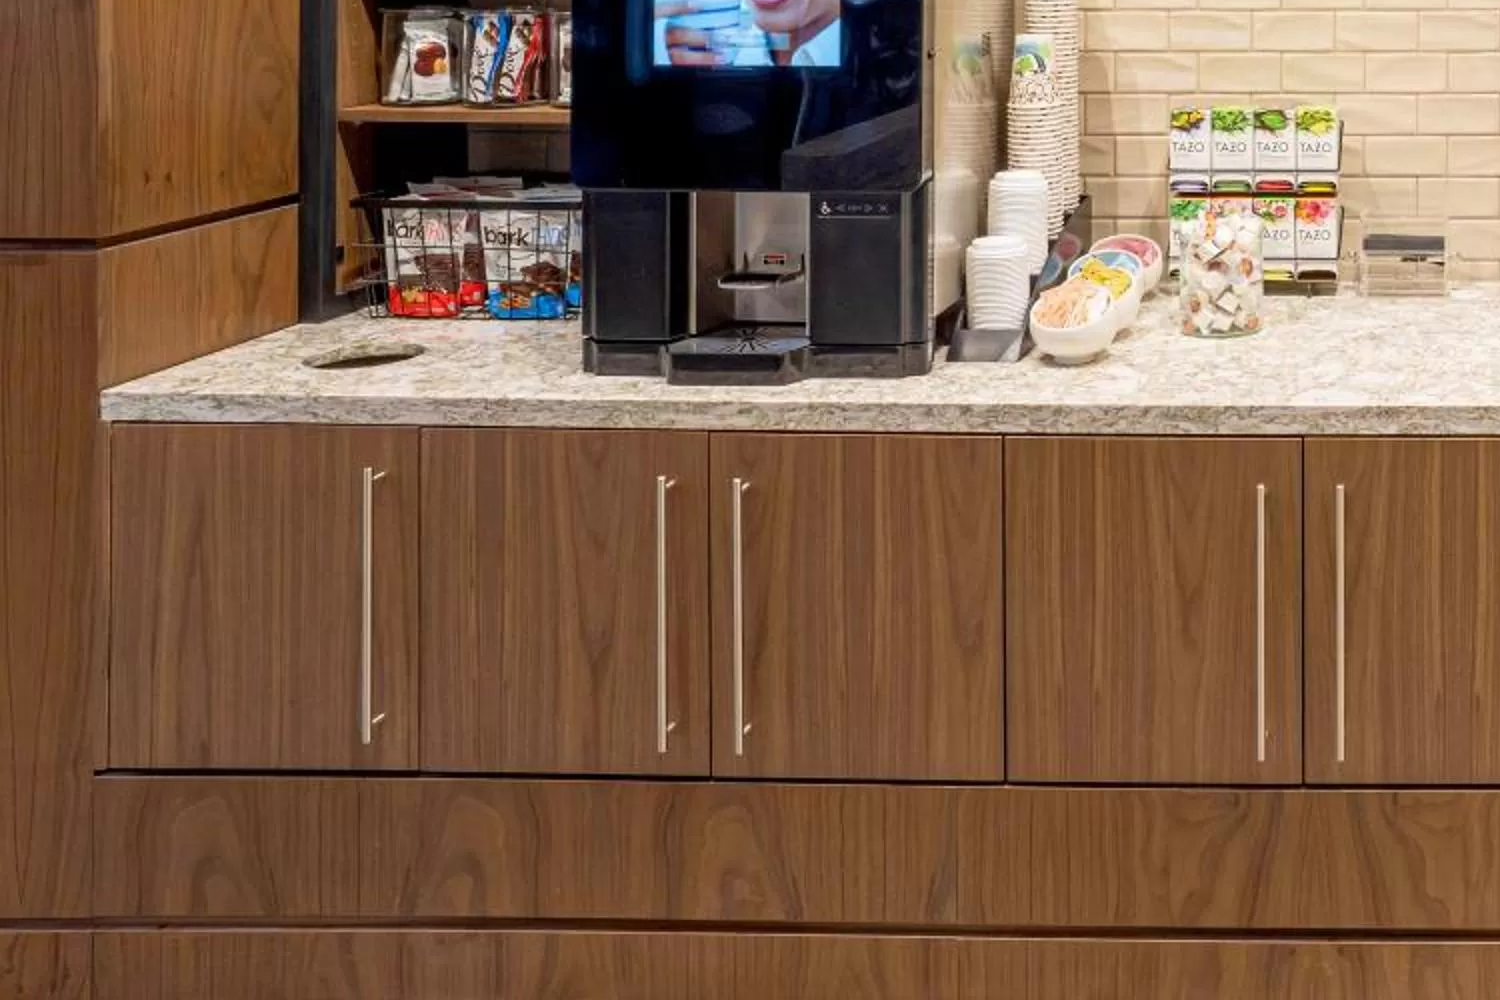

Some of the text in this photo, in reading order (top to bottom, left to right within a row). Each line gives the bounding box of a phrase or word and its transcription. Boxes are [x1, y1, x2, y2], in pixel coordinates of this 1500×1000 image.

[1172, 141, 1204, 153] TAZO
[1215, 141, 1247, 153] TAZO
[1256, 141, 1289, 153] TAZO
[1300, 141, 1332, 153] TAZO
[1264, 229, 1290, 241] AZO
[1298, 229, 1332, 241] TAZO
